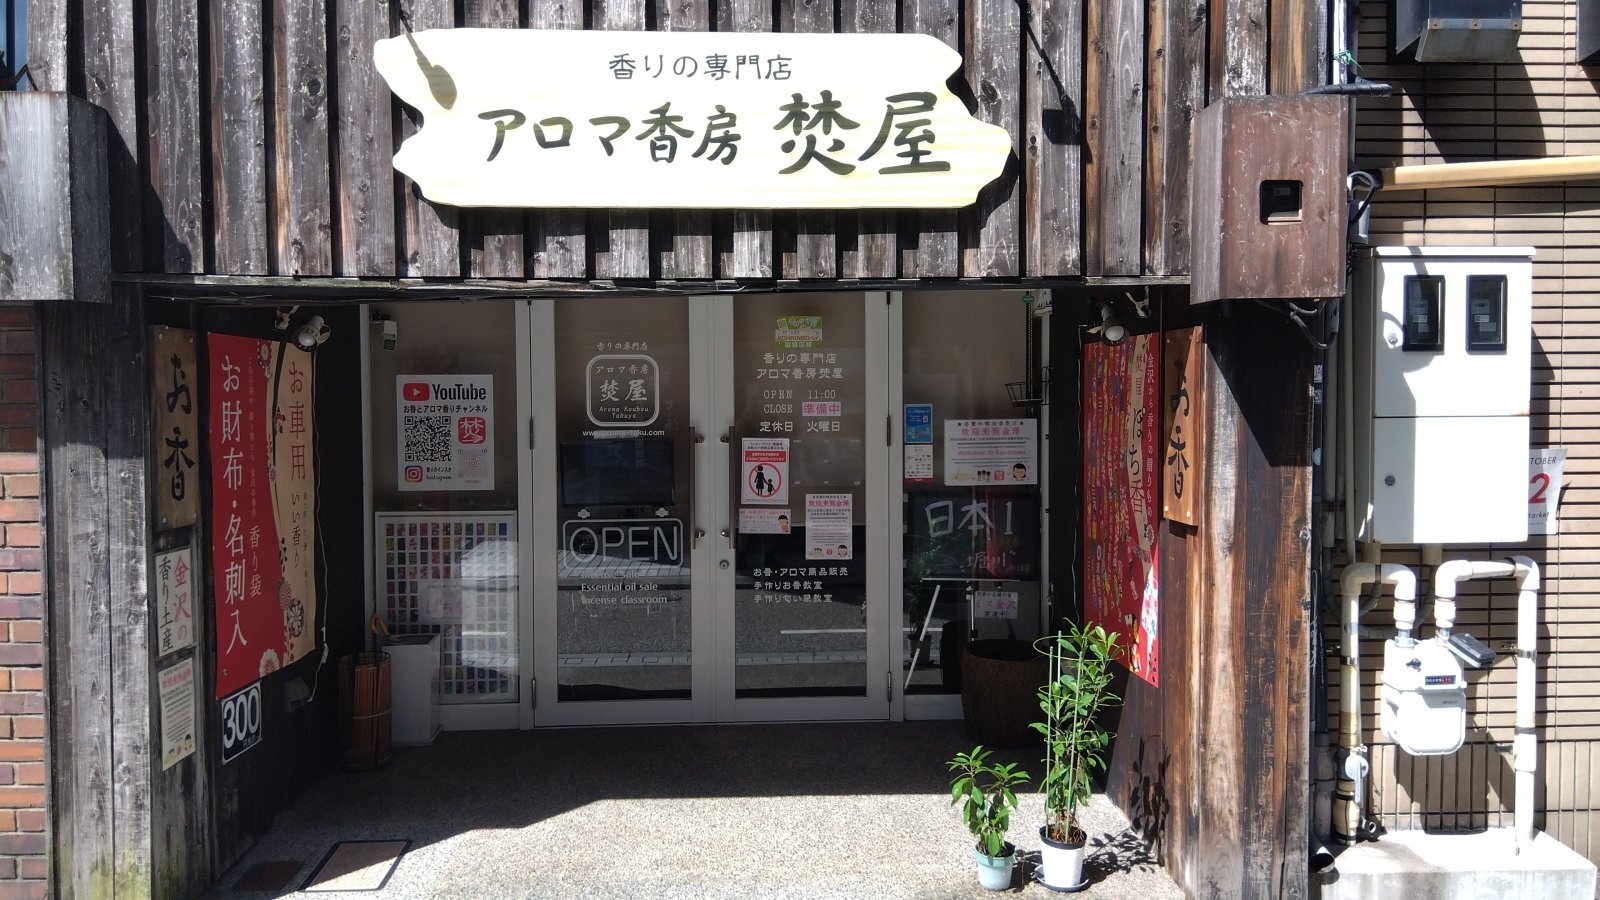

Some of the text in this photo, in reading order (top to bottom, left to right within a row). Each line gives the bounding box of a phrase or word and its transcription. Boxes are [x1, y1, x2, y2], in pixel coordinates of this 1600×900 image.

[608, 53, 793, 81] 香りの専門店
[772, 89, 951, 176] 焚屋
[596, 341, 649, 352] 香りの専門店
[762, 352, 837, 364] 香りの専門店
[595, 363, 649, 375] アロマ香房
[756, 367, 844, 379] アロマ香房焚屋
[431, 383, 487, 400] YouTube
[599, 378, 648, 402] 焚屋
[763, 389, 836, 399] OPEN 11:00
[403, 404, 488, 413] お香とアロマ香りチャンネル
[763, 403, 793, 414] CLOSE
[803, 403, 840, 415] 準備中
[163, 352, 196, 501] お香
[288, 361, 306, 482] お車用
[760, 421, 840, 432] 定休日 火曜日
[1167, 357, 1190, 500] お香
[1530, 456, 1557, 465] TOBER
[1528, 511, 1550, 519] arket
[569, 525, 678, 562] OPEN
[248, 524, 263, 599] 香り袋
[581, 581, 659, 592] Essential oil sale
[753, 581, 823, 590] 手作りお香教室
[158, 556, 174, 653] 香り土産
[172, 555, 192, 642] 金沢の
[620, 594, 668, 604] classroom
[223, 687, 260, 749] 300
